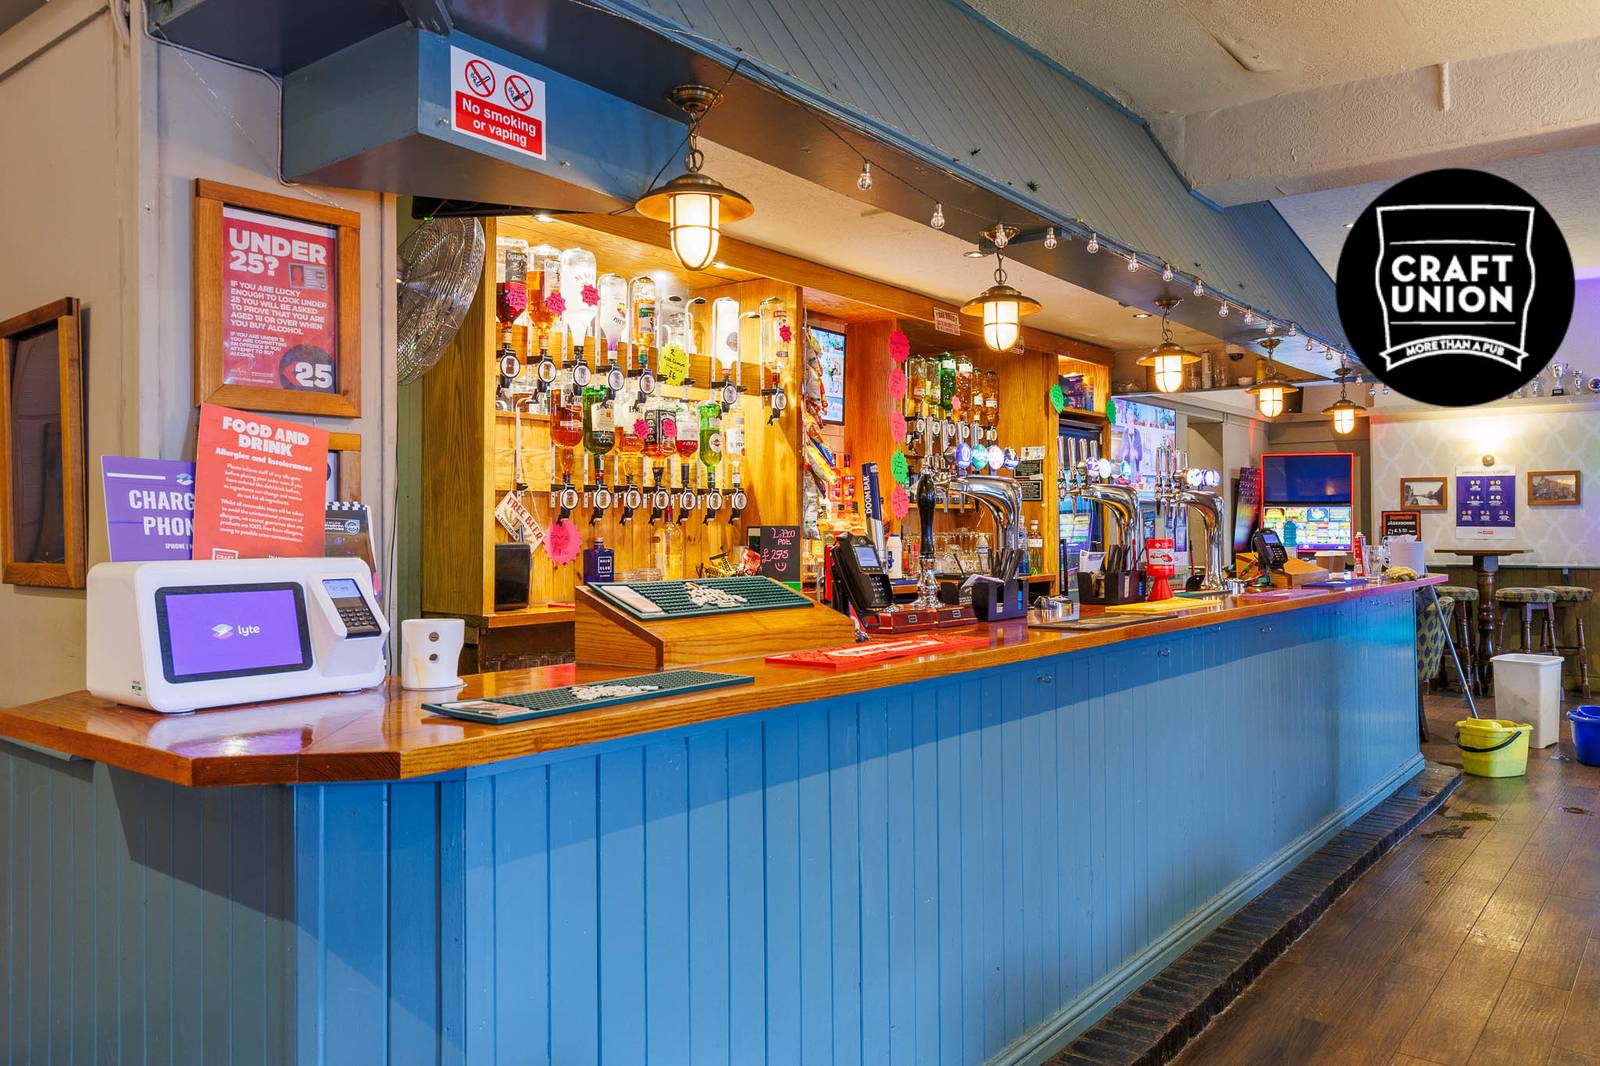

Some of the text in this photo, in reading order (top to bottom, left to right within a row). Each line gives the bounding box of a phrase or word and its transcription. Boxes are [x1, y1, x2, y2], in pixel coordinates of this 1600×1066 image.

[462, 97, 536, 136] No smoking
[473, 119, 527, 147] or vaping
[230, 228, 326, 264] UNDER
[230, 250, 279, 276] 25?
[231, 288, 327, 309] ENOUGH TO LOOK UNDER
[240, 282, 256, 290] YOU
[258, 284, 274, 293] ARE
[276, 287, 300, 297] LUCKY
[244, 306, 269, 315] PROVE
[272, 310, 290, 318] THAT
[292, 312, 308, 320] YOU
[309, 315, 325, 323] ARE
[260, 300, 279, 309] WILL
[292, 305, 317, 314] ASKED
[231, 312, 253, 320] AGED
[277, 318, 298, 327] OVER
[299, 321, 322, 330] WHEN
[231, 319, 248, 328] YOU
[249, 322, 266, 330] BUY
[295, 362, 332, 388] 25
[222, 416, 310, 446] FOOD AND
[216, 448, 250, 460] Allergies
[252, 455, 266, 464] and
[238, 434, 292, 457] DRINK
[507, 497, 543, 540] FREE BEER
[238, 624, 260, 636] lyte
